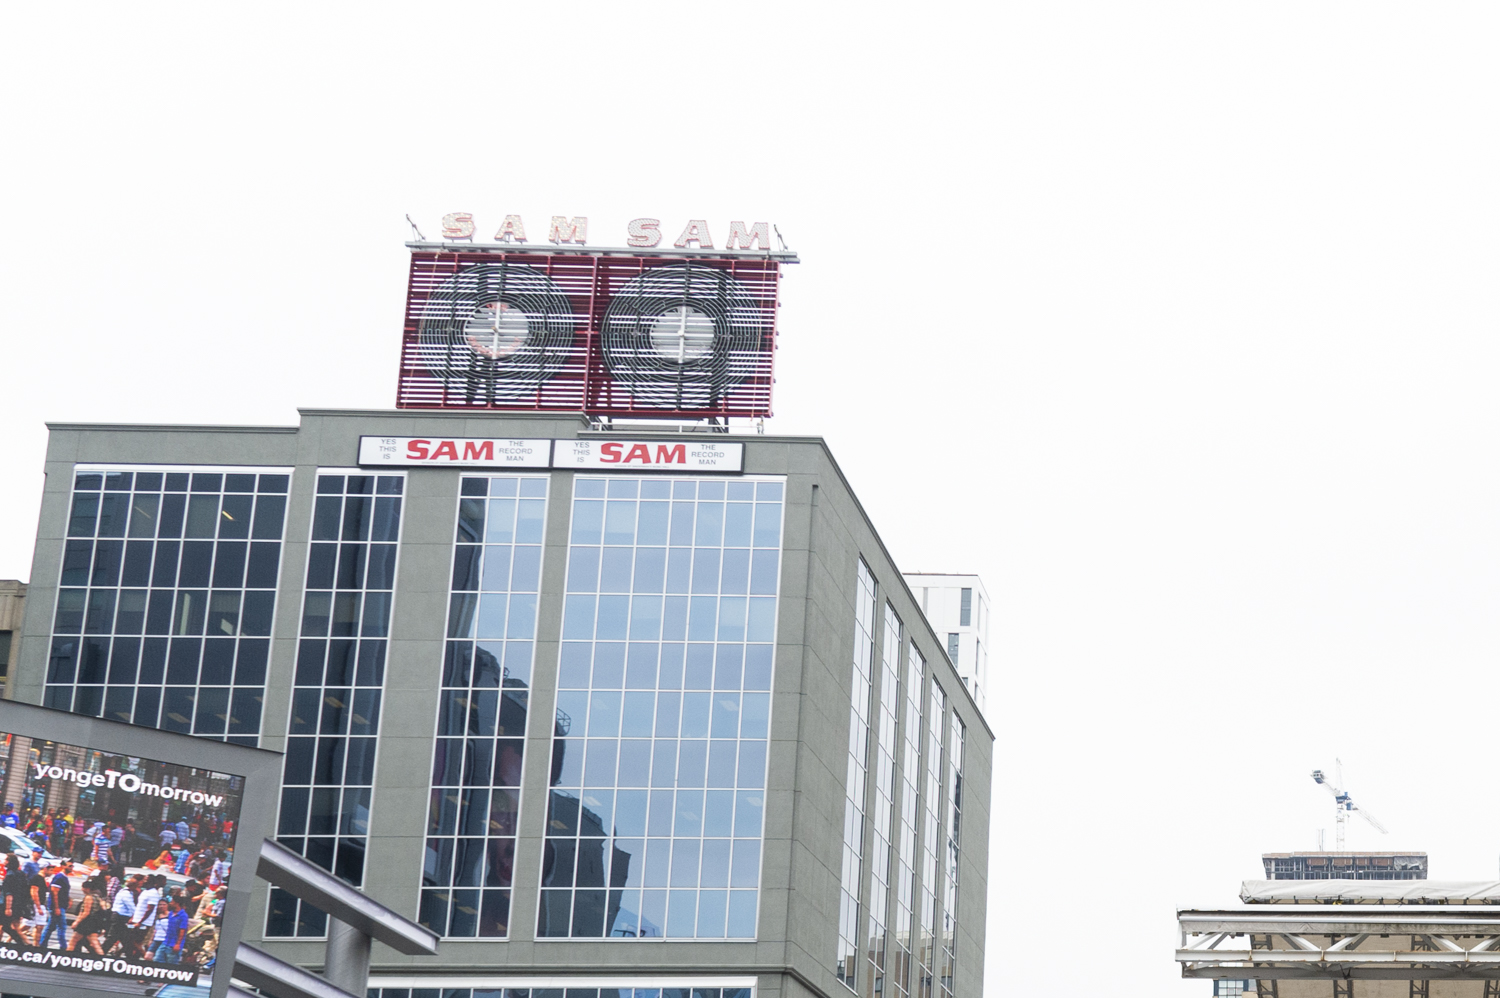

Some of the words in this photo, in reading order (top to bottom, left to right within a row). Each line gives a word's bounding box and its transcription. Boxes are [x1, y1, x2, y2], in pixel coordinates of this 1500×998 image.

[441, 212, 588, 244] SAM
[627, 218, 770, 250] SAM
[406, 440, 494, 461] SAM
[600, 442, 686, 464] SAM
[34, 763, 223, 807] yongeTOmorrow
